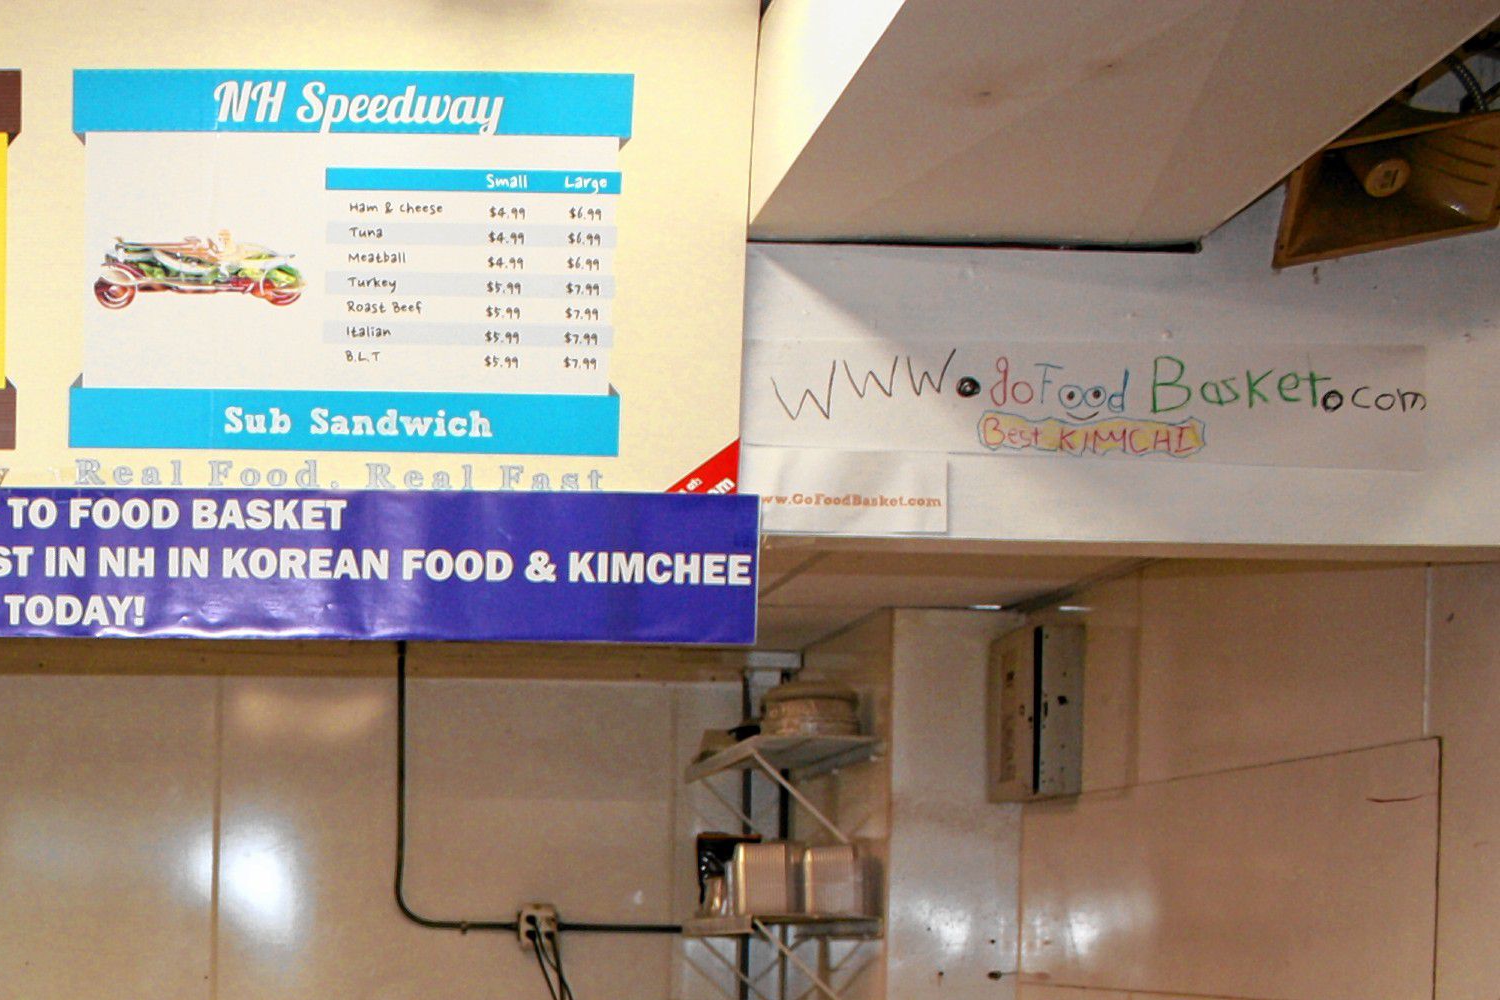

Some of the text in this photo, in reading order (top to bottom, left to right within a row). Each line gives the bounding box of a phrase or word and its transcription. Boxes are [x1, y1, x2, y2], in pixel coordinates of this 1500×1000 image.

[213, 80, 505, 136] NH Speedway
[486, 174, 608, 194] Small Large
[349, 202, 378, 213] Ham
[385, 202, 393, 214] &
[489, 206, 526, 220] $4.99
[568, 206, 602, 220] $6.99
[349, 226, 601, 246] Tuna $4.99 $6.99
[348, 252, 600, 270] Meatball $4.99 $6.99
[347, 276, 600, 296] Turkey $5.99 $7.99
[346, 301, 599, 321] Roast Beef $5.99 $7.99
[346, 325, 598, 345] Italian $5.99 $7.99
[484, 356, 519, 369] $5.99
[563, 356, 597, 370] $7.99
[223, 406, 493, 438] Sub Sandwich
[982, 417, 1043, 447] Best
[74, 458, 604, 491] Real Food. Real Fast
[7, 498, 58, 529] TO
[69, 498, 180, 530] FOOD
[191, 499, 348, 531] BASKET
[44, 546, 86, 577] IN
[98, 547, 156, 578] NH
[167, 547, 209, 578] IN
[222, 547, 389, 580] KOREAN
[402, 549, 514, 582] FOOD
[525, 550, 557, 583] &
[568, 551, 752, 586] KIMCHEE
[4, 594, 147, 627] TODAY!
